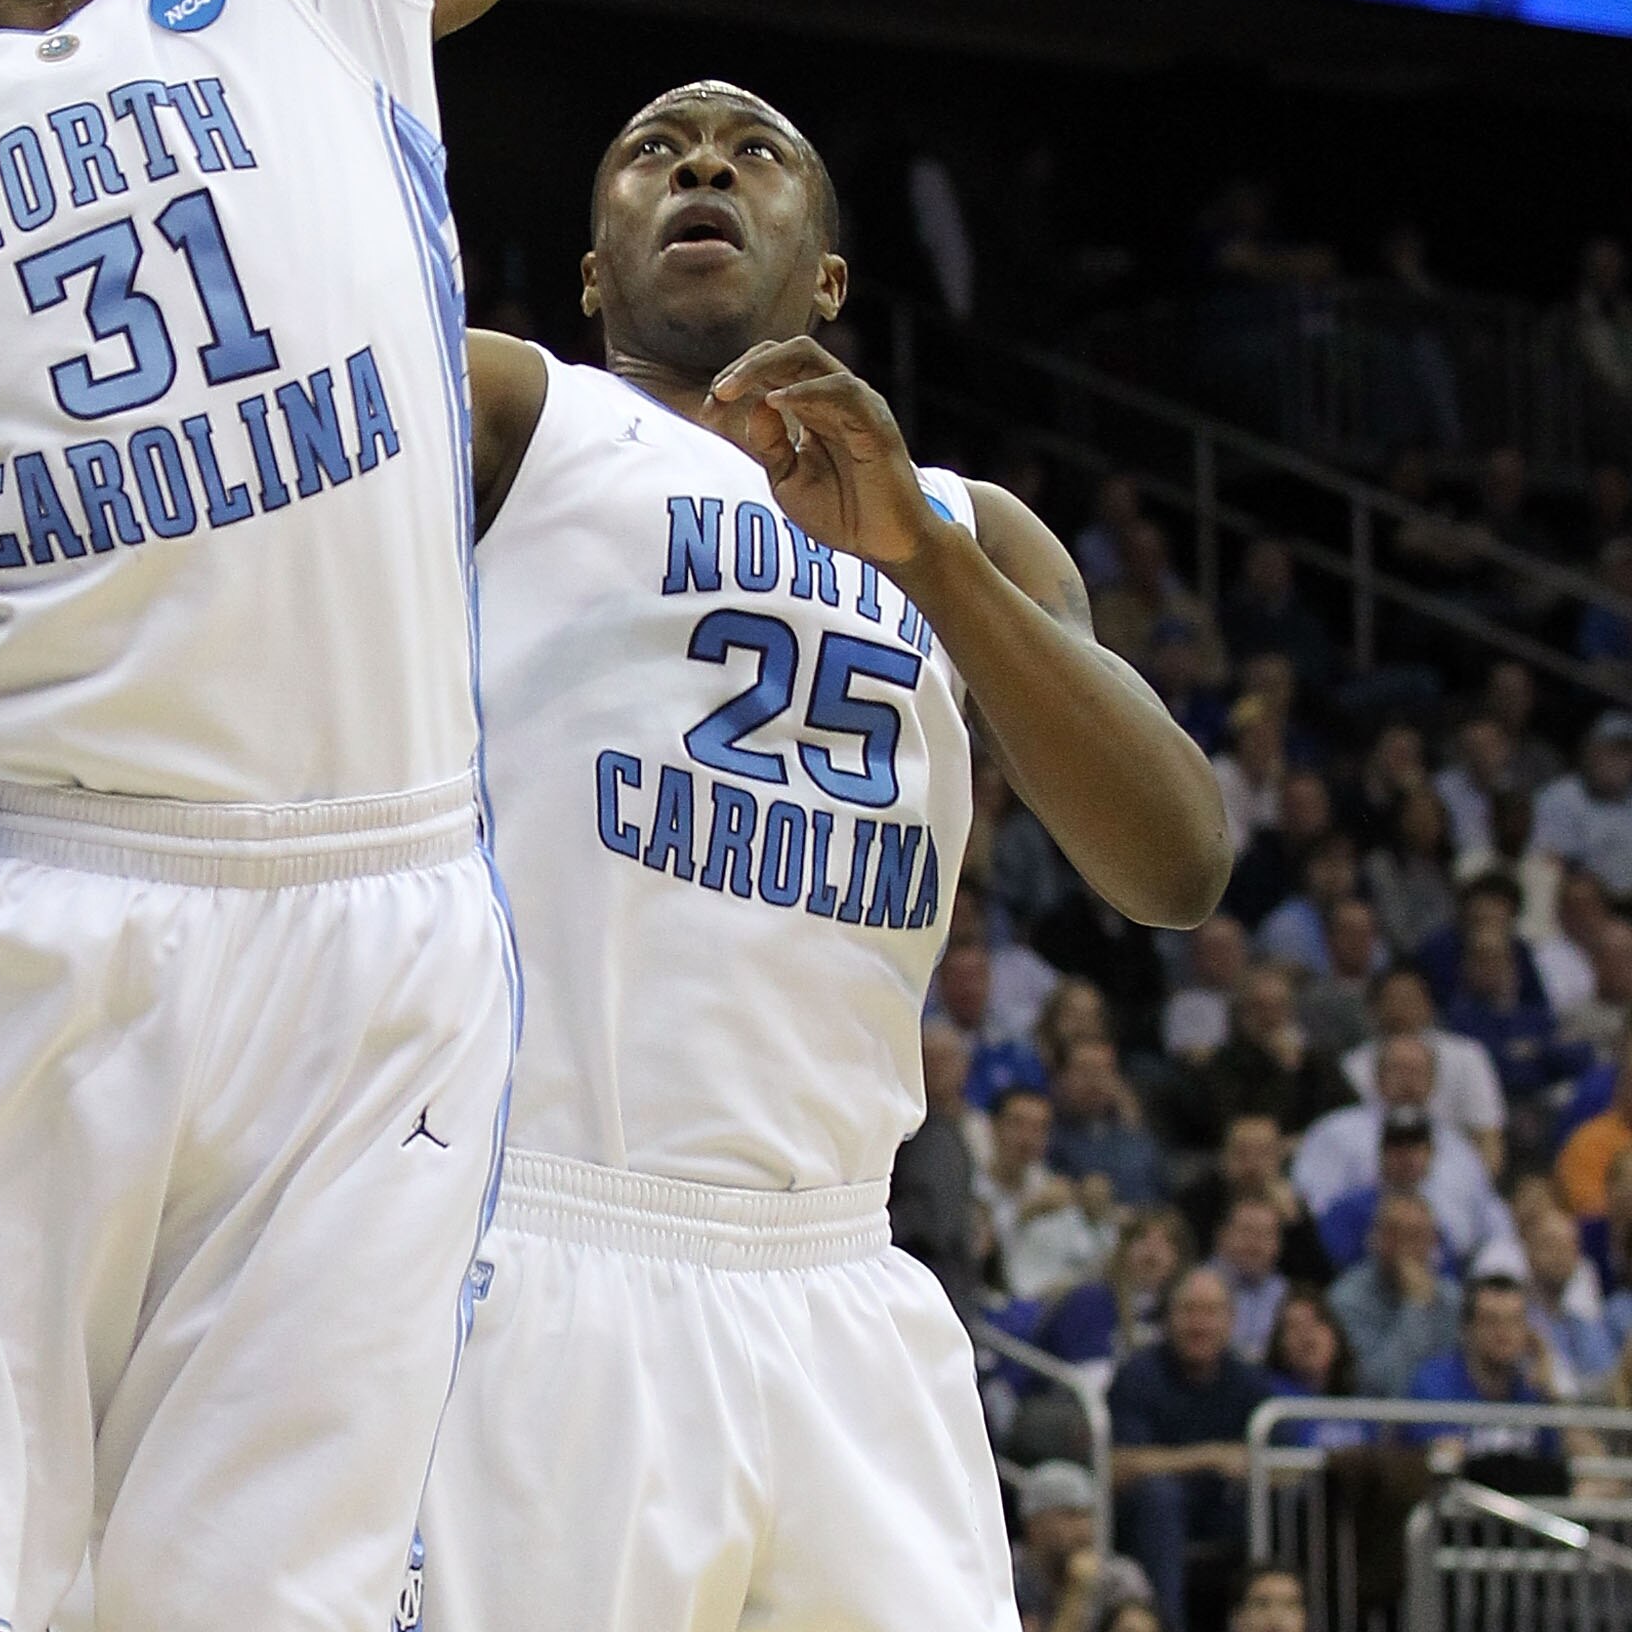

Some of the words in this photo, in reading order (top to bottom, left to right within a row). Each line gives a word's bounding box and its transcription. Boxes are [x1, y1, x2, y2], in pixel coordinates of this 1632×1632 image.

[13, 186, 280, 420] 31
[683, 608, 922, 808] 25
[594, 749, 940, 930] CAROLINA
